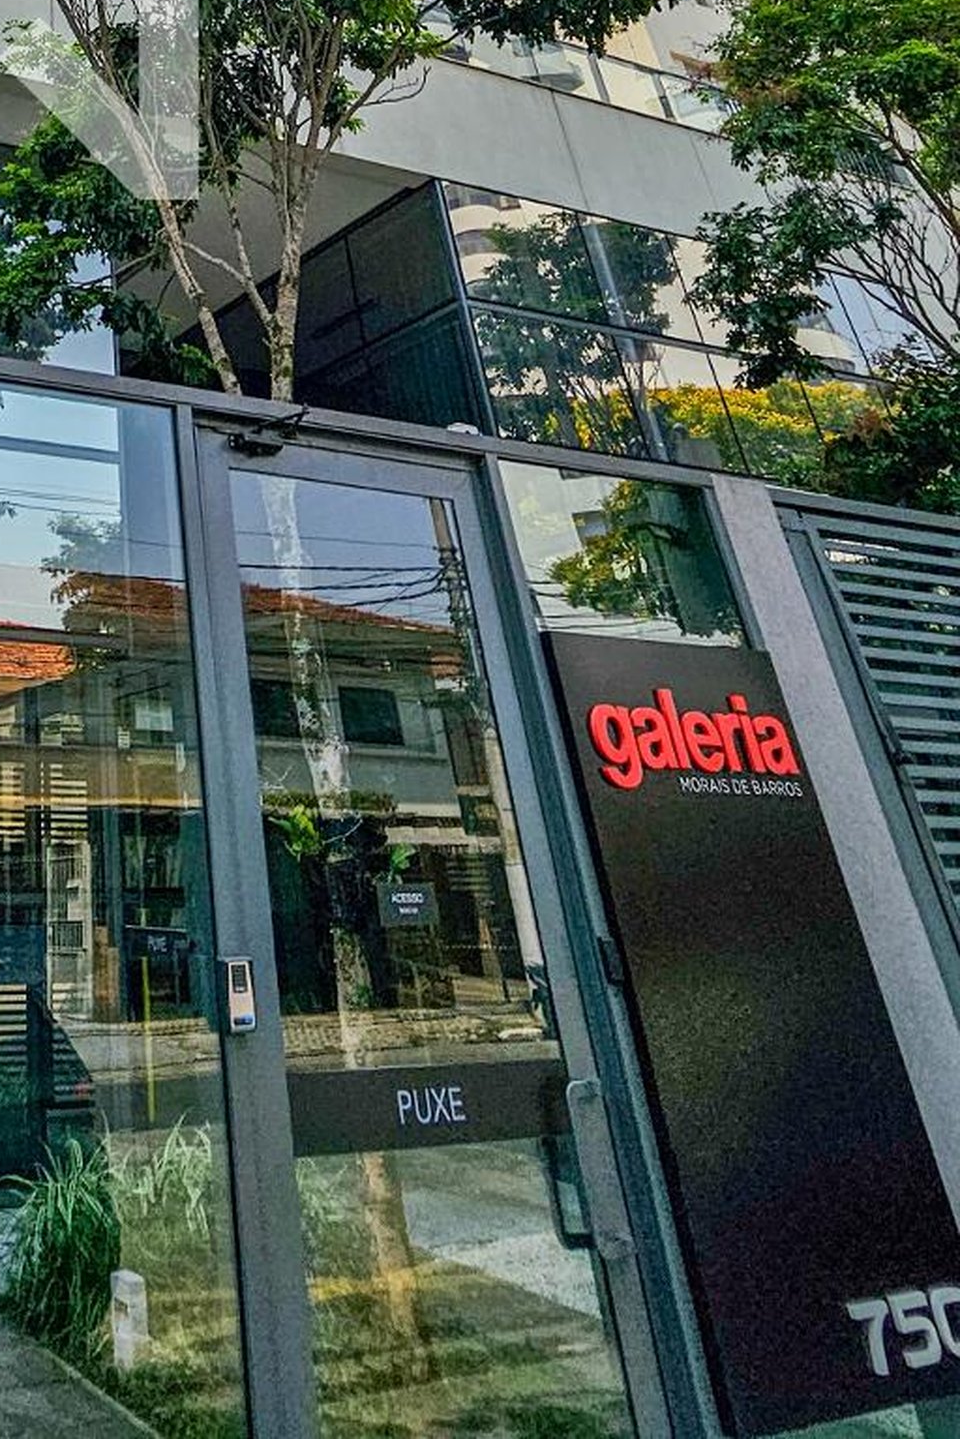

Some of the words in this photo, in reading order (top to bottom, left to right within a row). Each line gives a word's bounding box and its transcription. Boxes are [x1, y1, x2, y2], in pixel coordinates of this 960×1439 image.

[588, 688, 801, 790] galeria
[679, 776, 730, 794] MORAIS
[731, 778, 751, 795] DE
[752, 779, 803, 797] BARROS
[397, 1087, 466, 1125] PUXE
